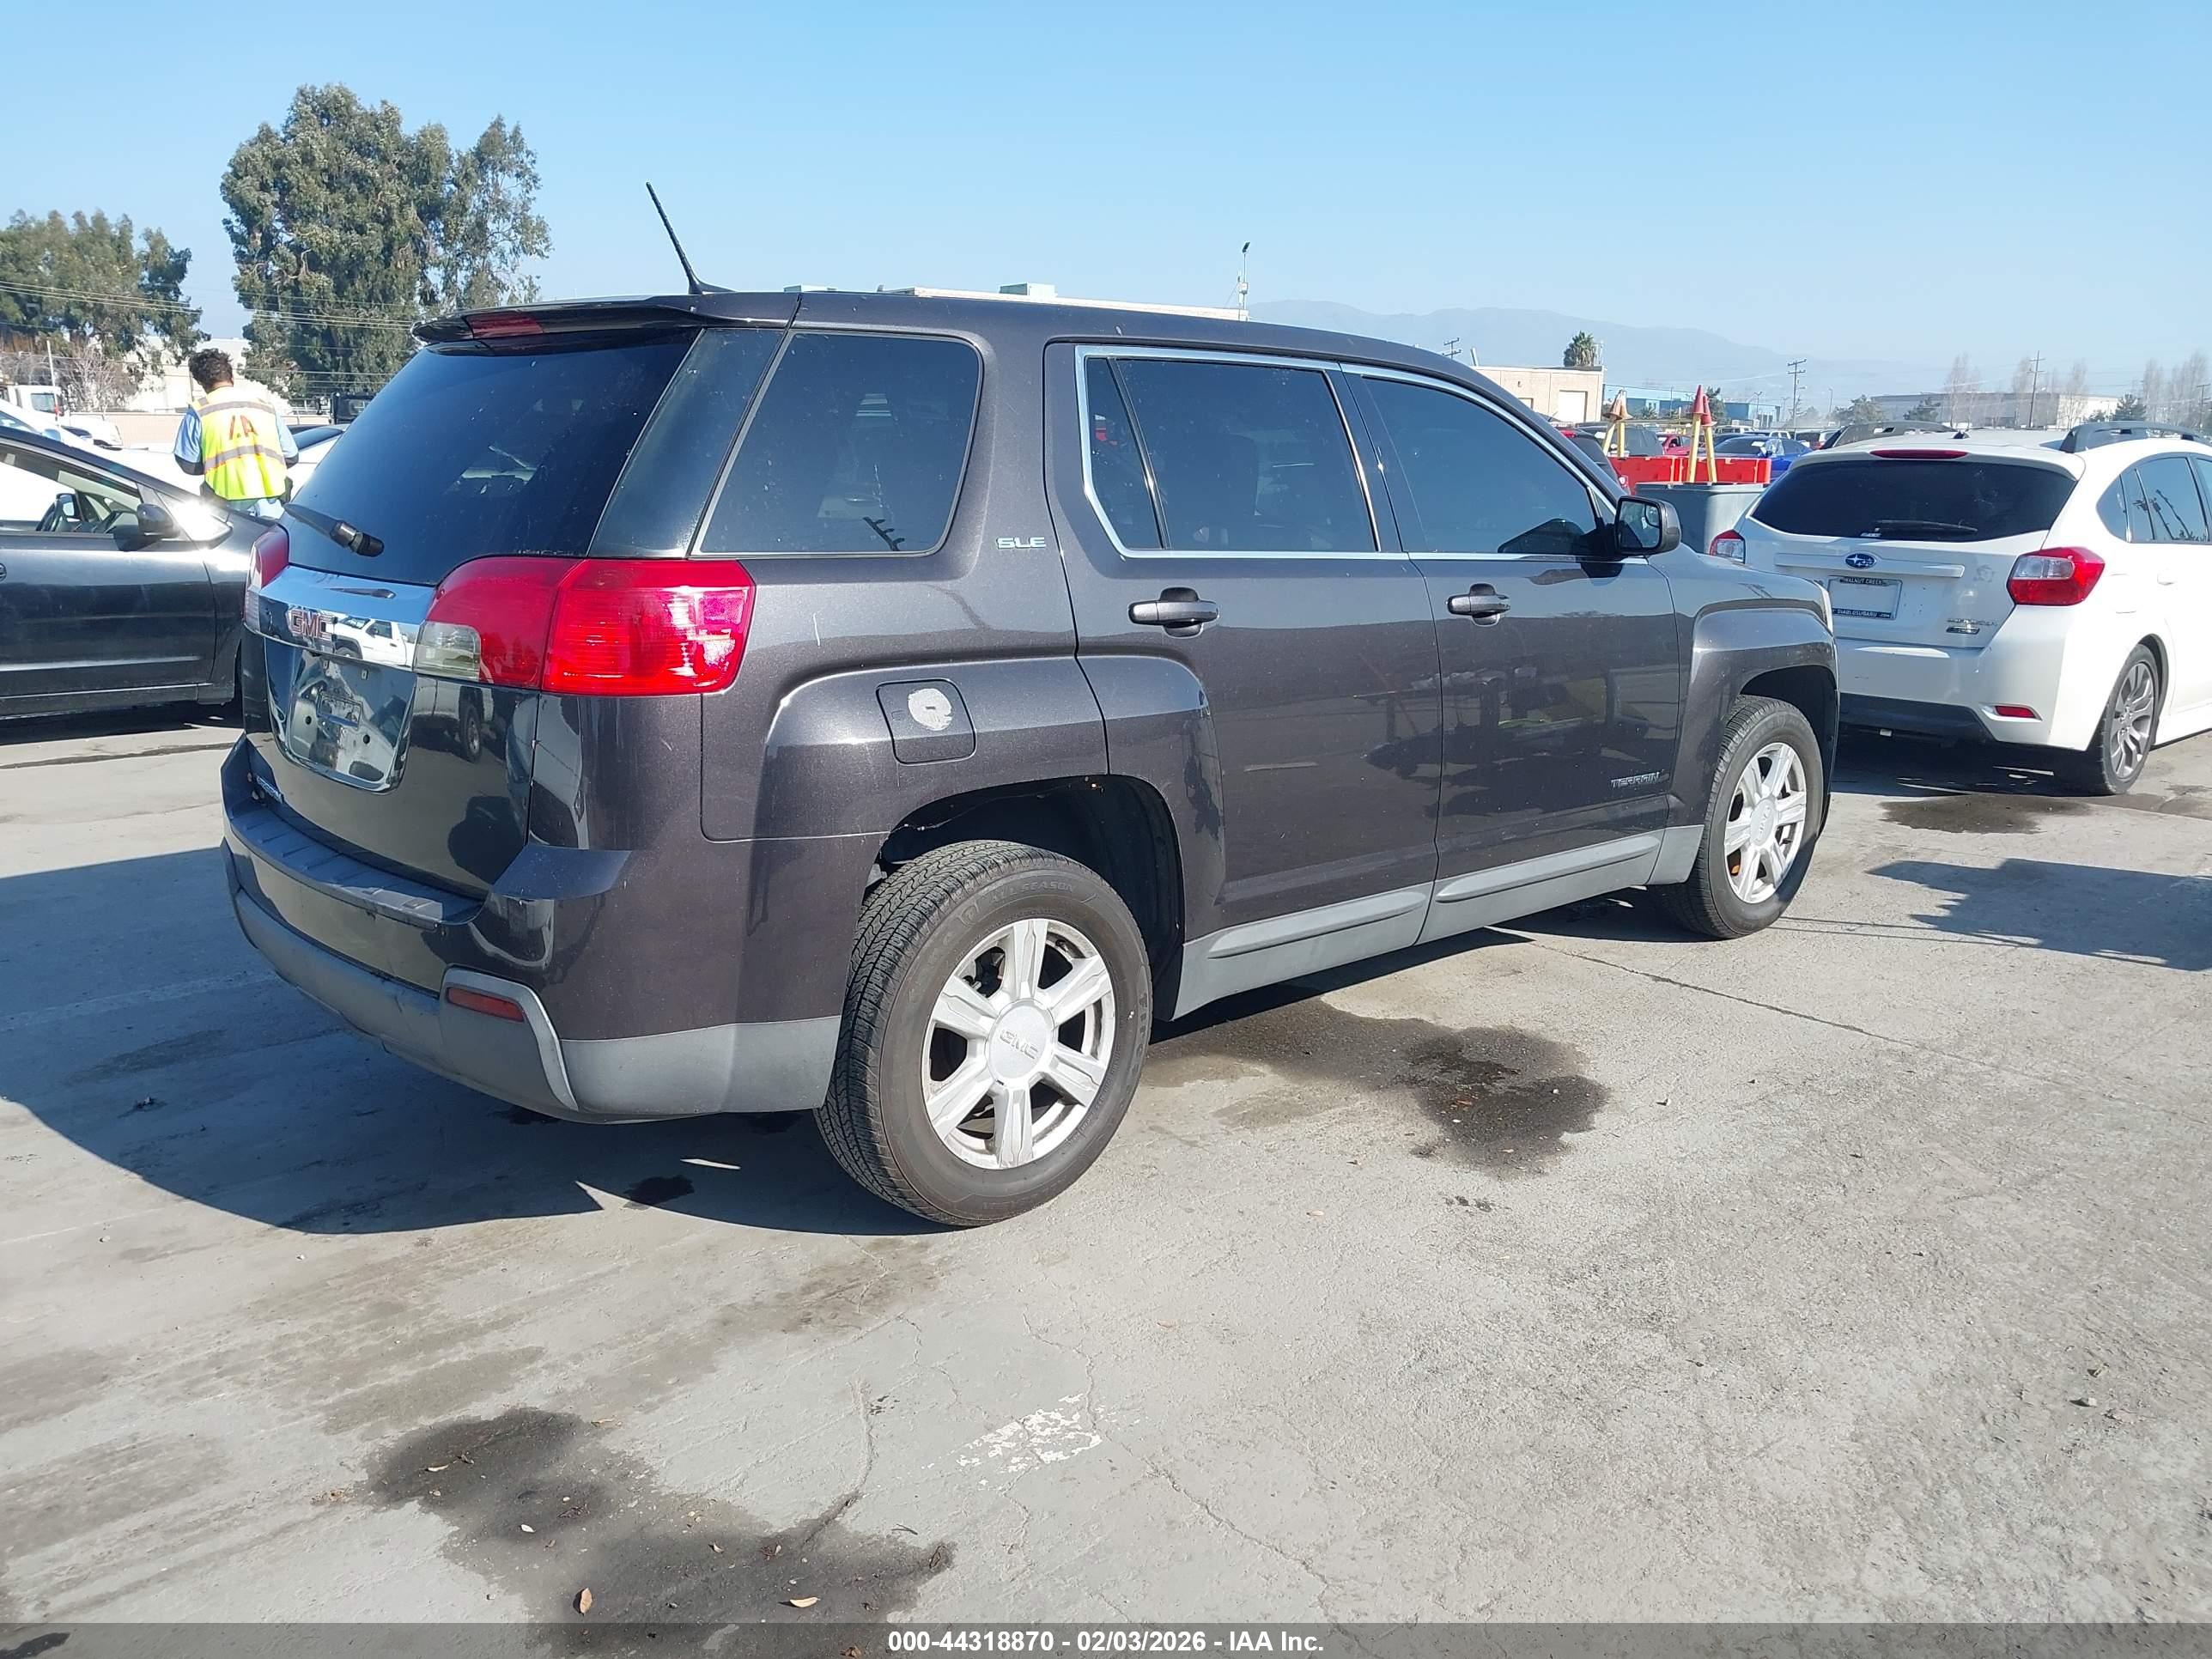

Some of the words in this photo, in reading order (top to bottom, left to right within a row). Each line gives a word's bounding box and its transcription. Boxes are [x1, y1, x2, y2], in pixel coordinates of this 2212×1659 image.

[996, 537, 1046, 549] SLE
[286, 609, 333, 641] GMC
[1611, 772, 1661, 788] TERRAIN
